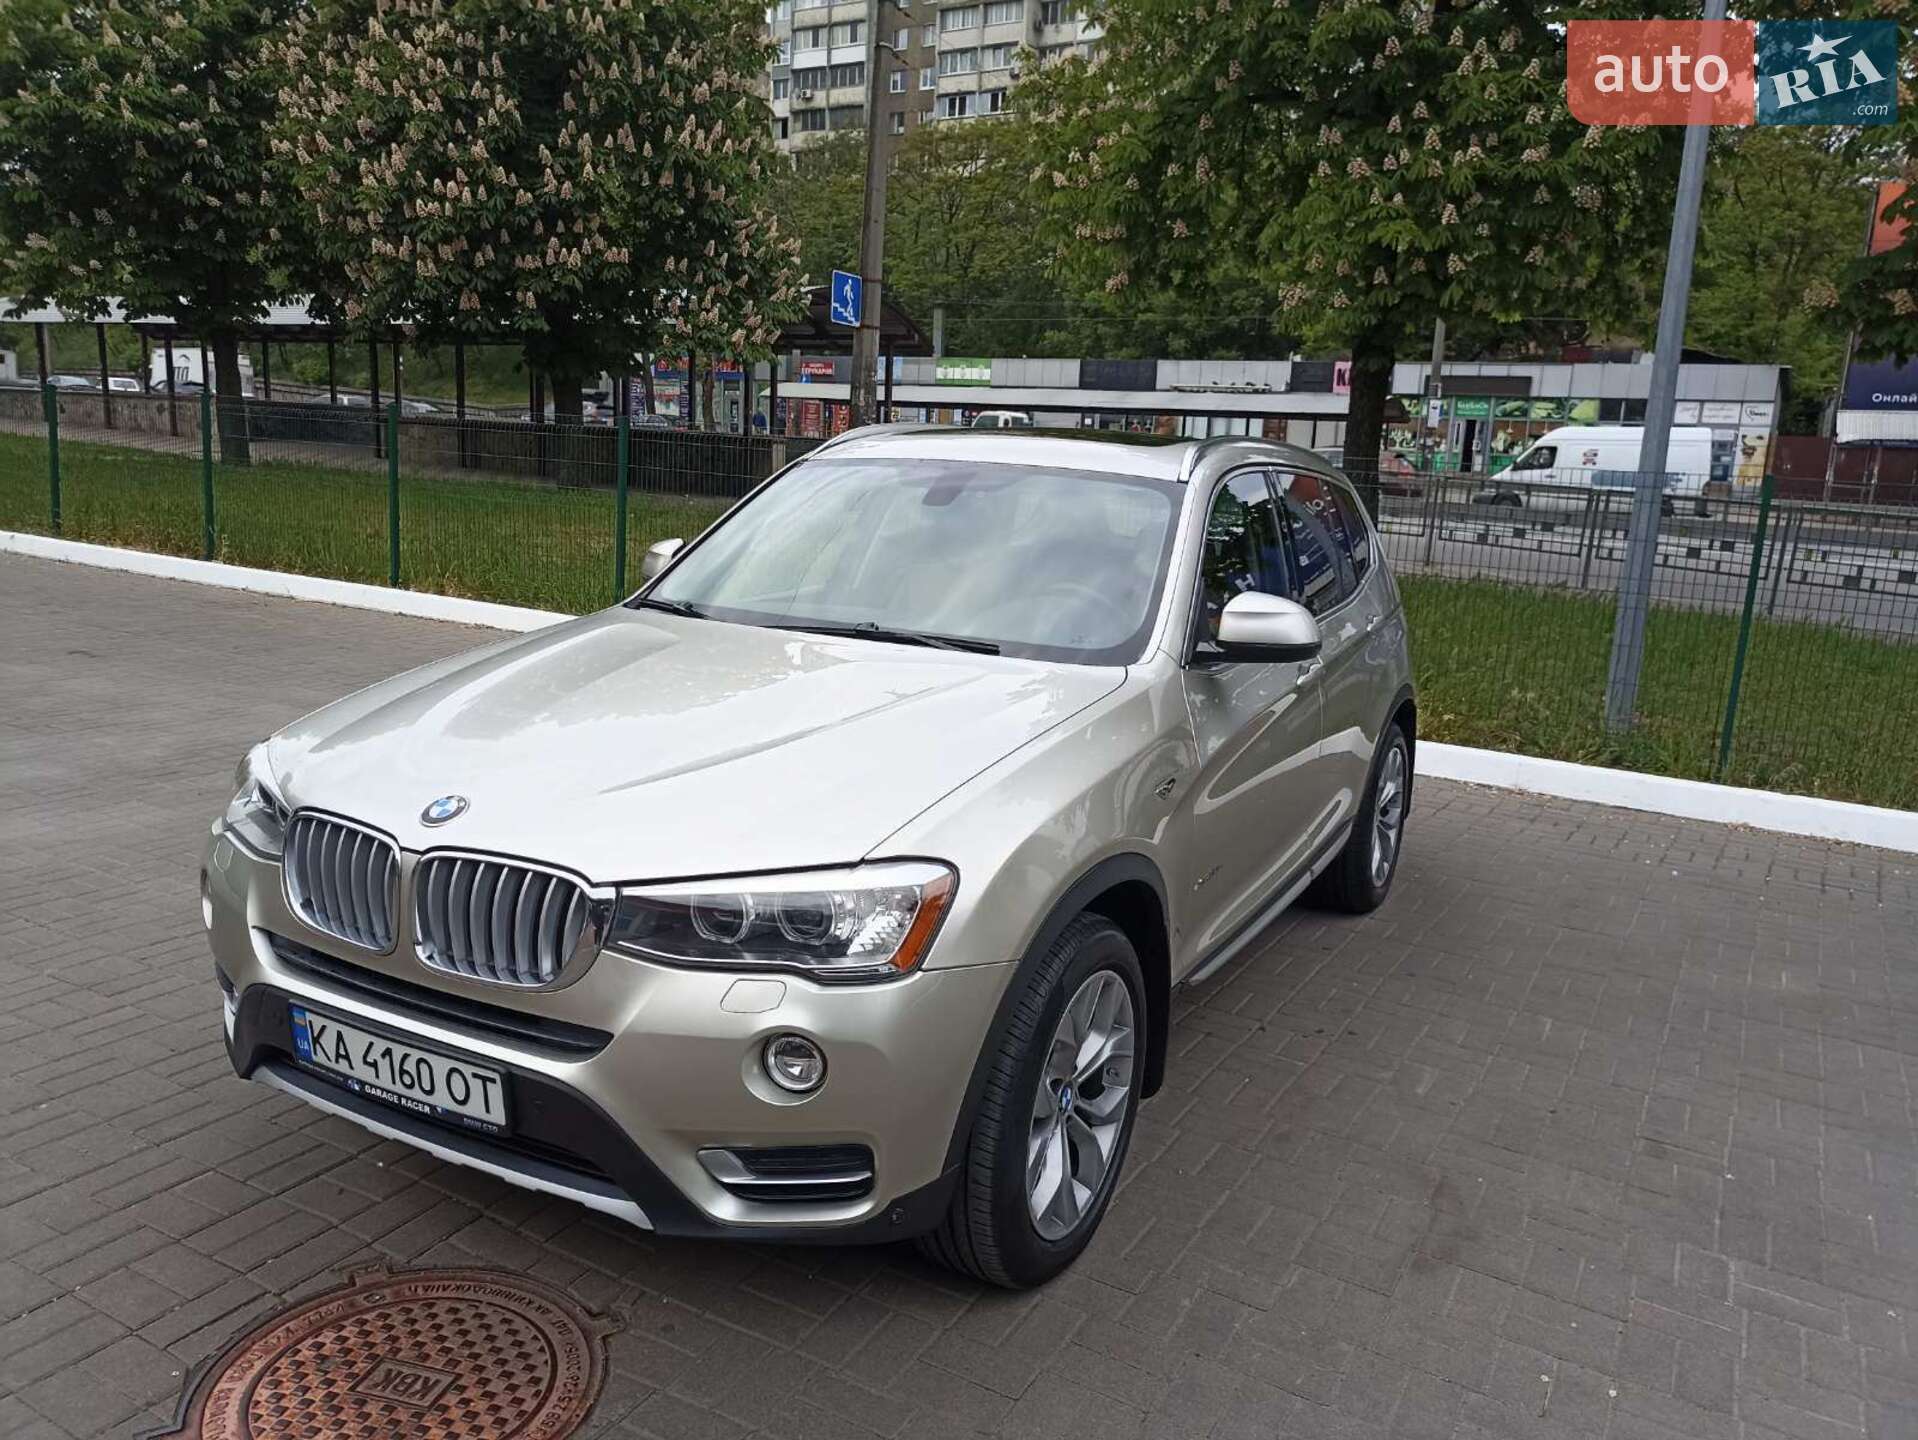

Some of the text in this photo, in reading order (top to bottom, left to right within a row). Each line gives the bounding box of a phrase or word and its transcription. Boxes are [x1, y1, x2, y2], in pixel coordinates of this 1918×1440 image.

[297, 1038, 311, 1051] UA
[308, 1019, 355, 1071] KA
[362, 1041, 436, 1097] 4160
[445, 1066, 497, 1115] OT
[364, 1084, 431, 1115] GARAGE RACER
